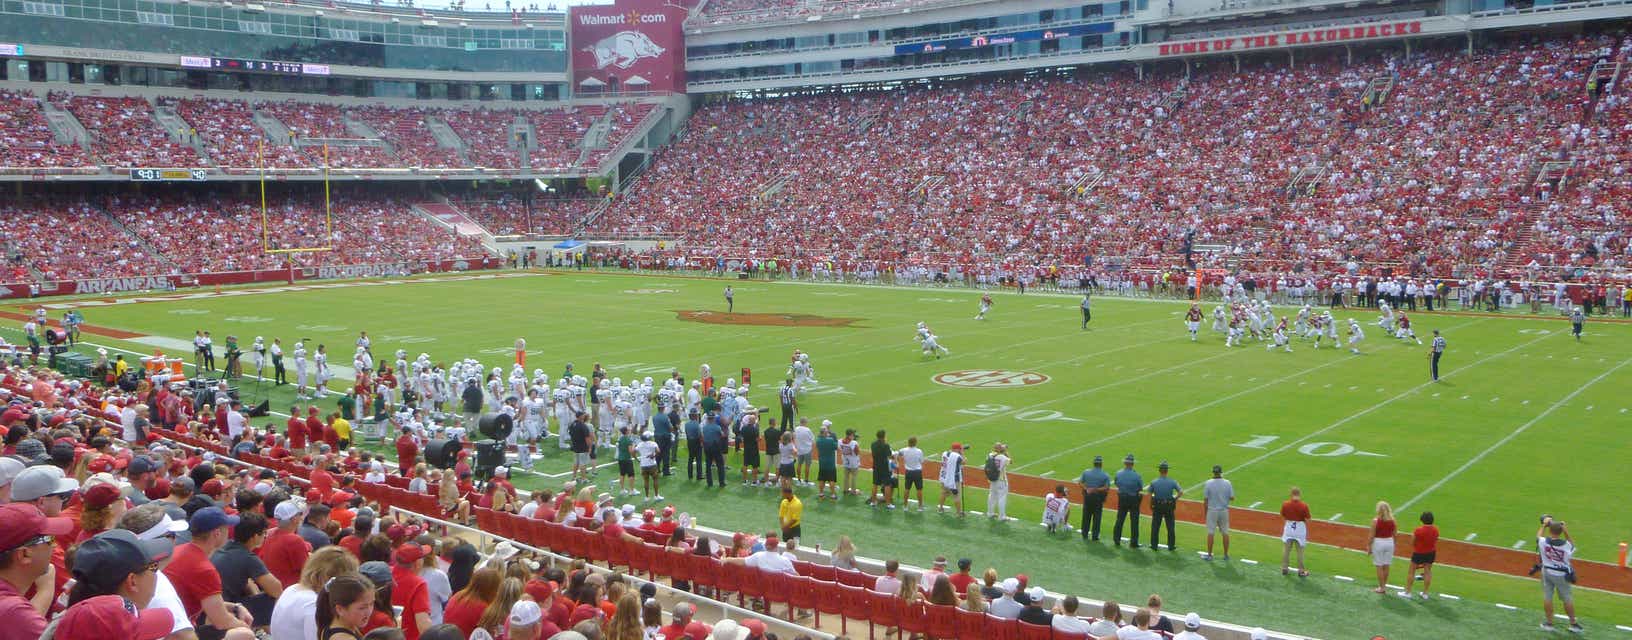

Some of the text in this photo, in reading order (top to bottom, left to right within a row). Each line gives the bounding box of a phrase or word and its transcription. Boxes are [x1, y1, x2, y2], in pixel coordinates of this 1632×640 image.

[580, 13, 666, 25] Walmart com
[1159, 21, 1422, 56] HOME OF THE RAZORBACKS
[138, 169, 160, 180] 9:01
[192, 170, 205, 180] 40
[955, 404, 1064, 421] 20
[1230, 435, 1355, 457] 10
